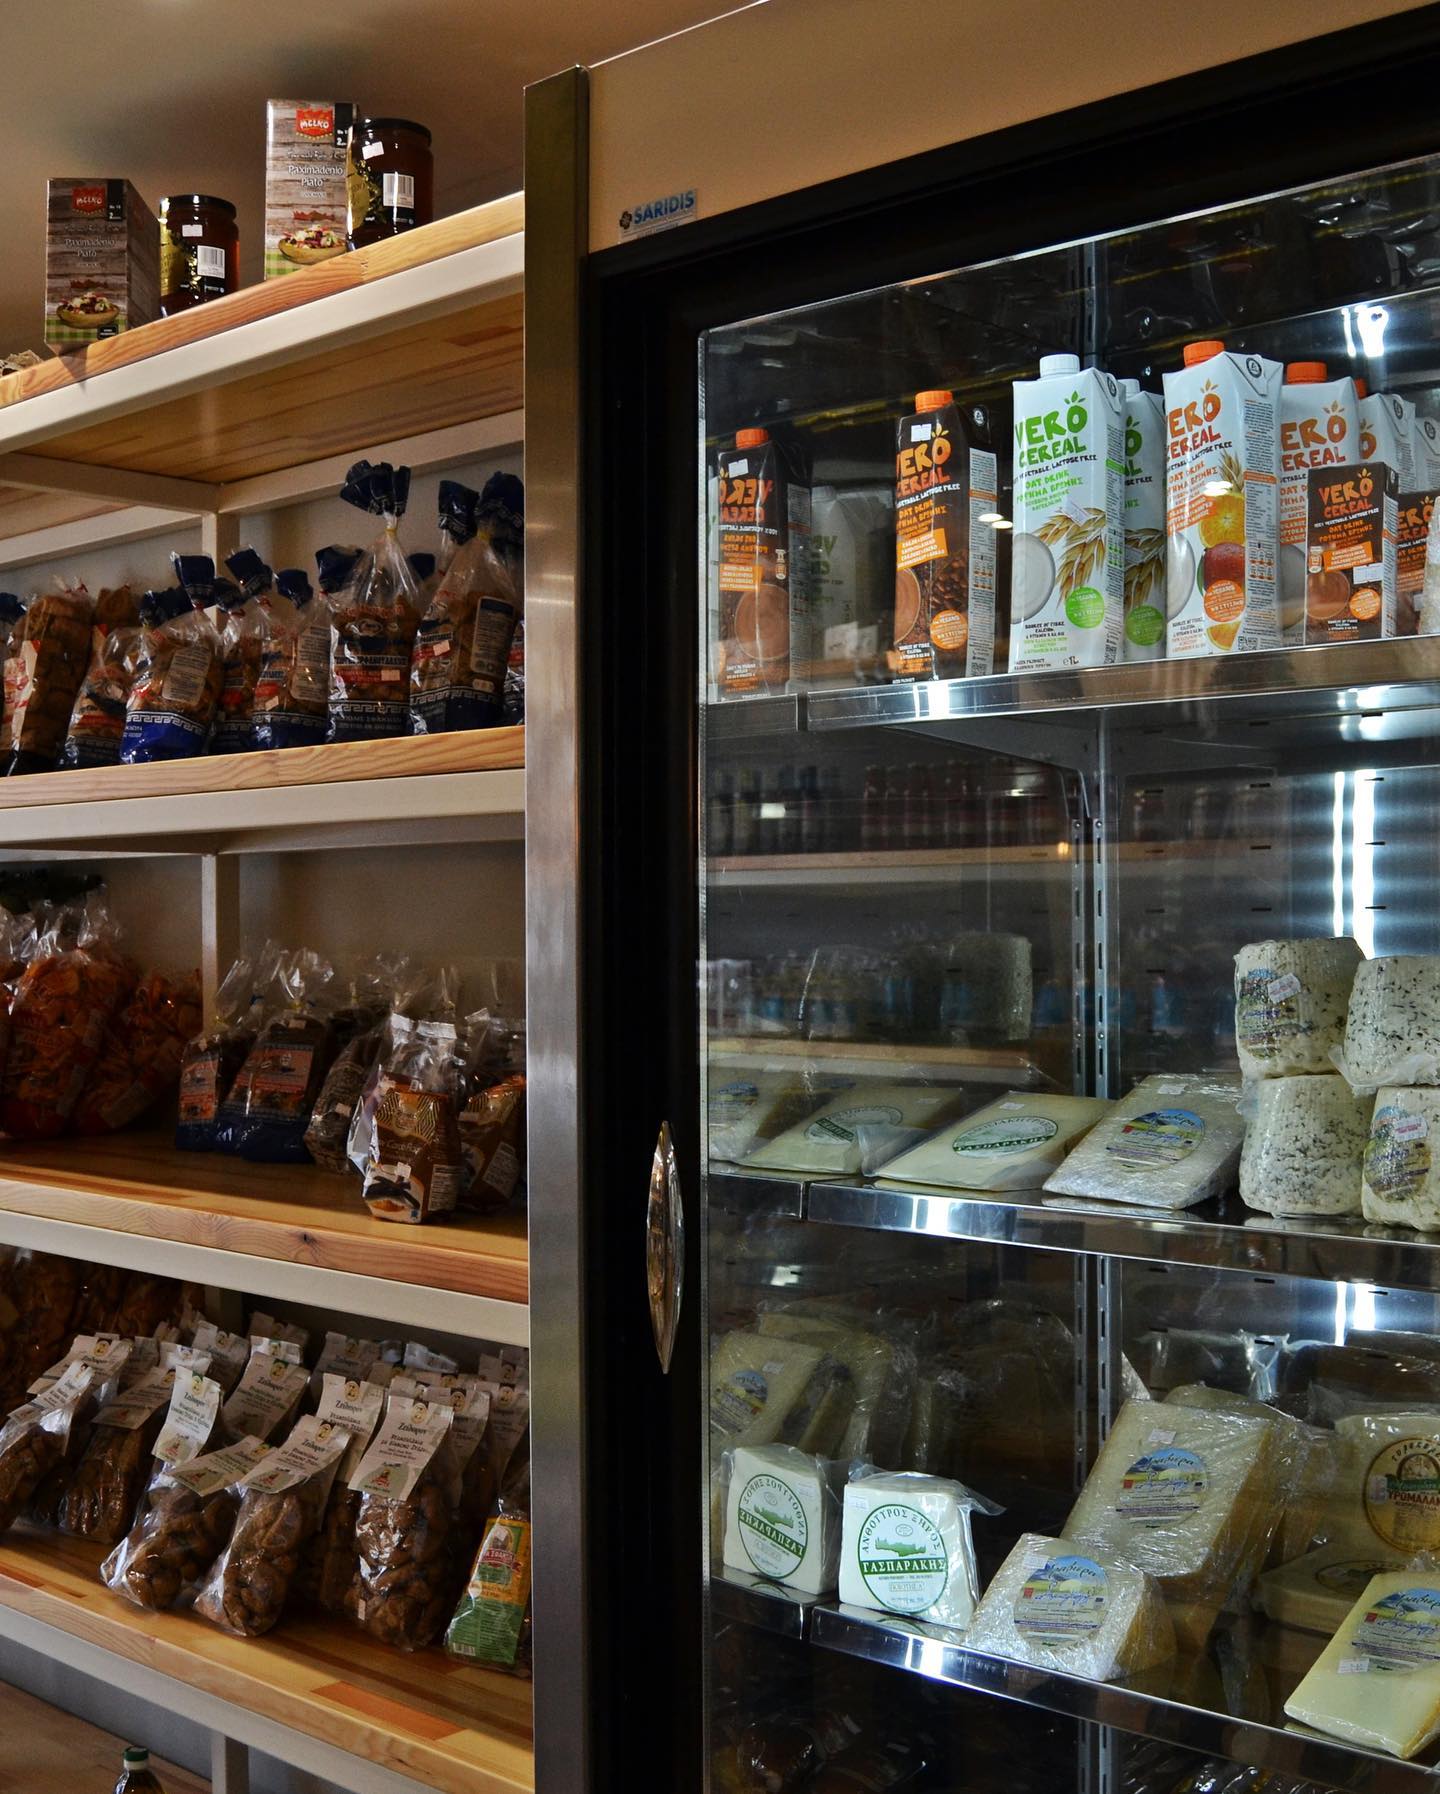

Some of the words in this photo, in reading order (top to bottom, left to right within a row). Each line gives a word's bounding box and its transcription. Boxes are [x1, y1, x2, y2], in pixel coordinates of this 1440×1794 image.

[634, 190, 695, 225] SARIDIS
[1015, 405, 1088, 448] VERO
[1167, 393, 1221, 439] ERO
[1214, 441, 1232, 450] FREE
[1280, 415, 1347, 451] ERO
[1019, 436, 1087, 468] CEREAL
[1052, 456, 1079, 469] LACTOSE
[1080, 454, 1097, 462] FREE
[1280, 447, 1346, 473] EREAL
[943, 483, 961, 492] FREE
[1025, 478, 1041, 489] OAT
[1318, 477, 1374, 505] VERO
[1324, 499, 1373, 519] CEREAL
[1398, 504, 1434, 530] ERO
[863, 1559, 946, 1573] ΓΑΣΠΑΡΑΚΗΣ
